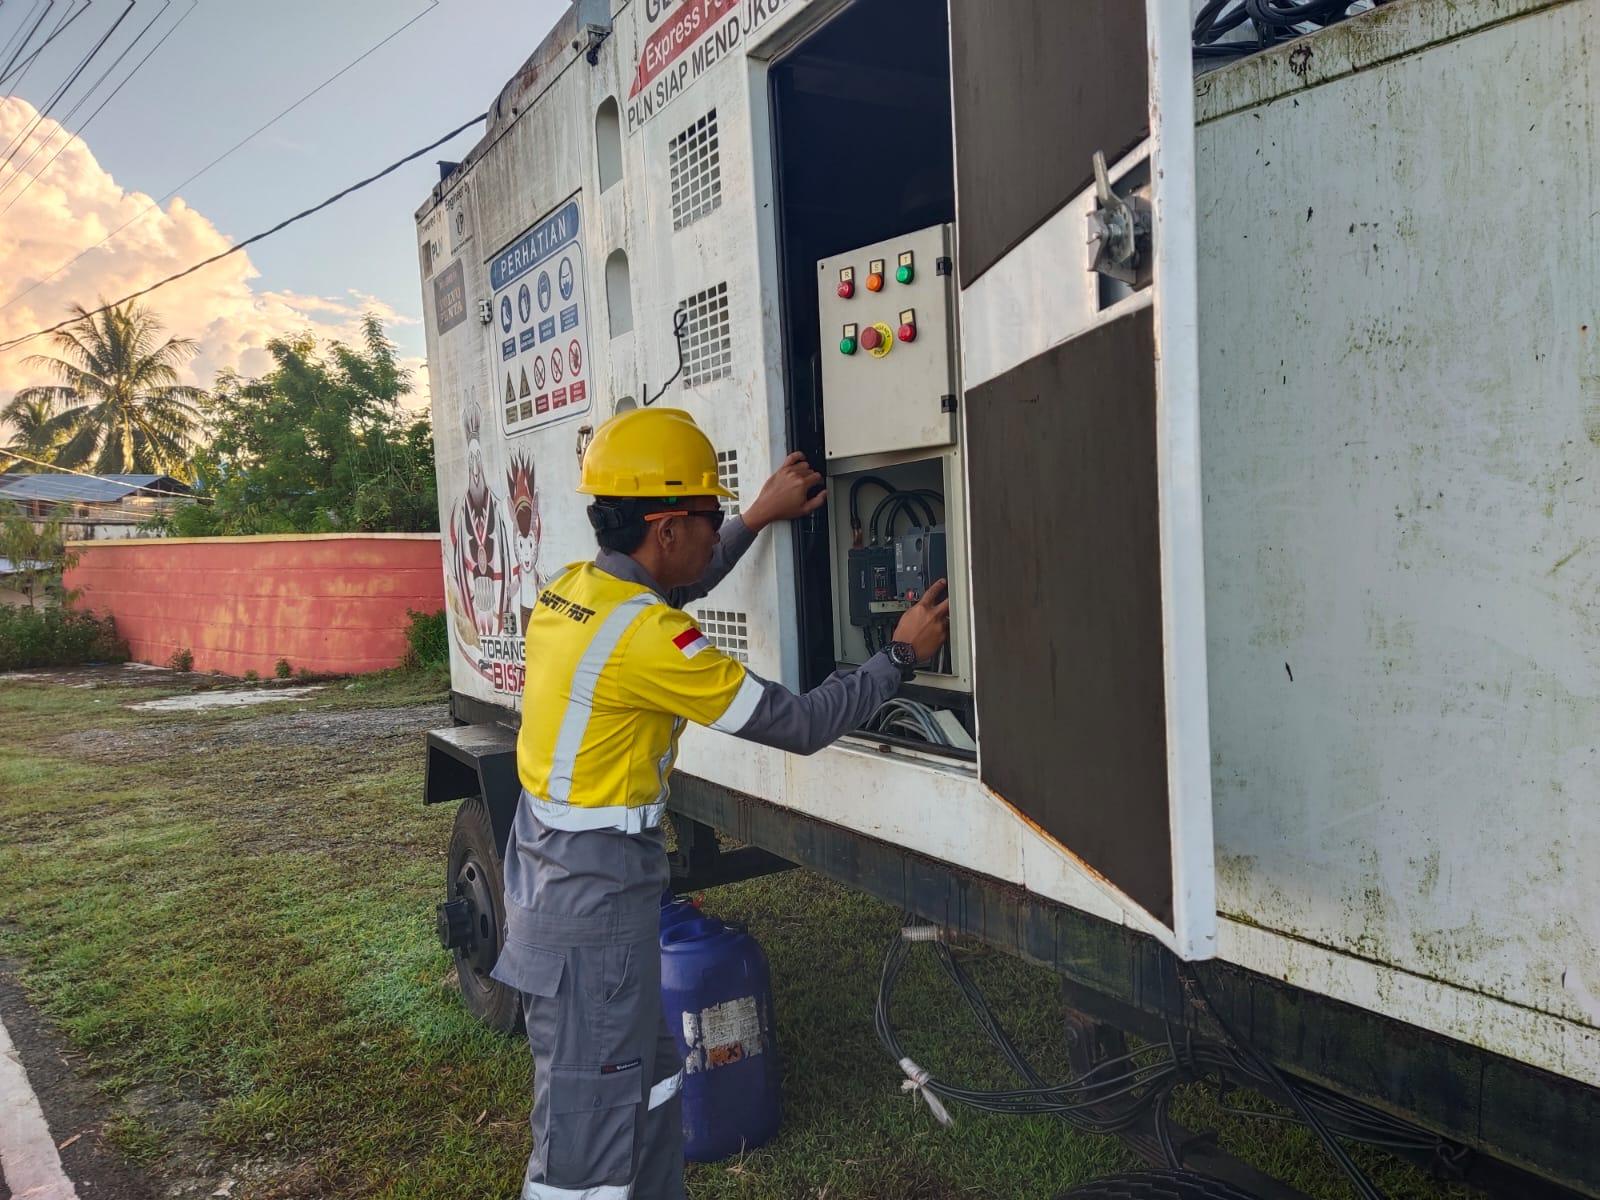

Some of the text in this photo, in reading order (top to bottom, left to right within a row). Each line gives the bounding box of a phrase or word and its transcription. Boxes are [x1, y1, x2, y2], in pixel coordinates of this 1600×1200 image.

[645, 6, 700, 73] Express
[627, 89, 653, 133] PLN
[656, 60, 688, 109] SIAP
[500, 215, 567, 281] PERHATIAN
[493, 662, 526, 693] BISA
